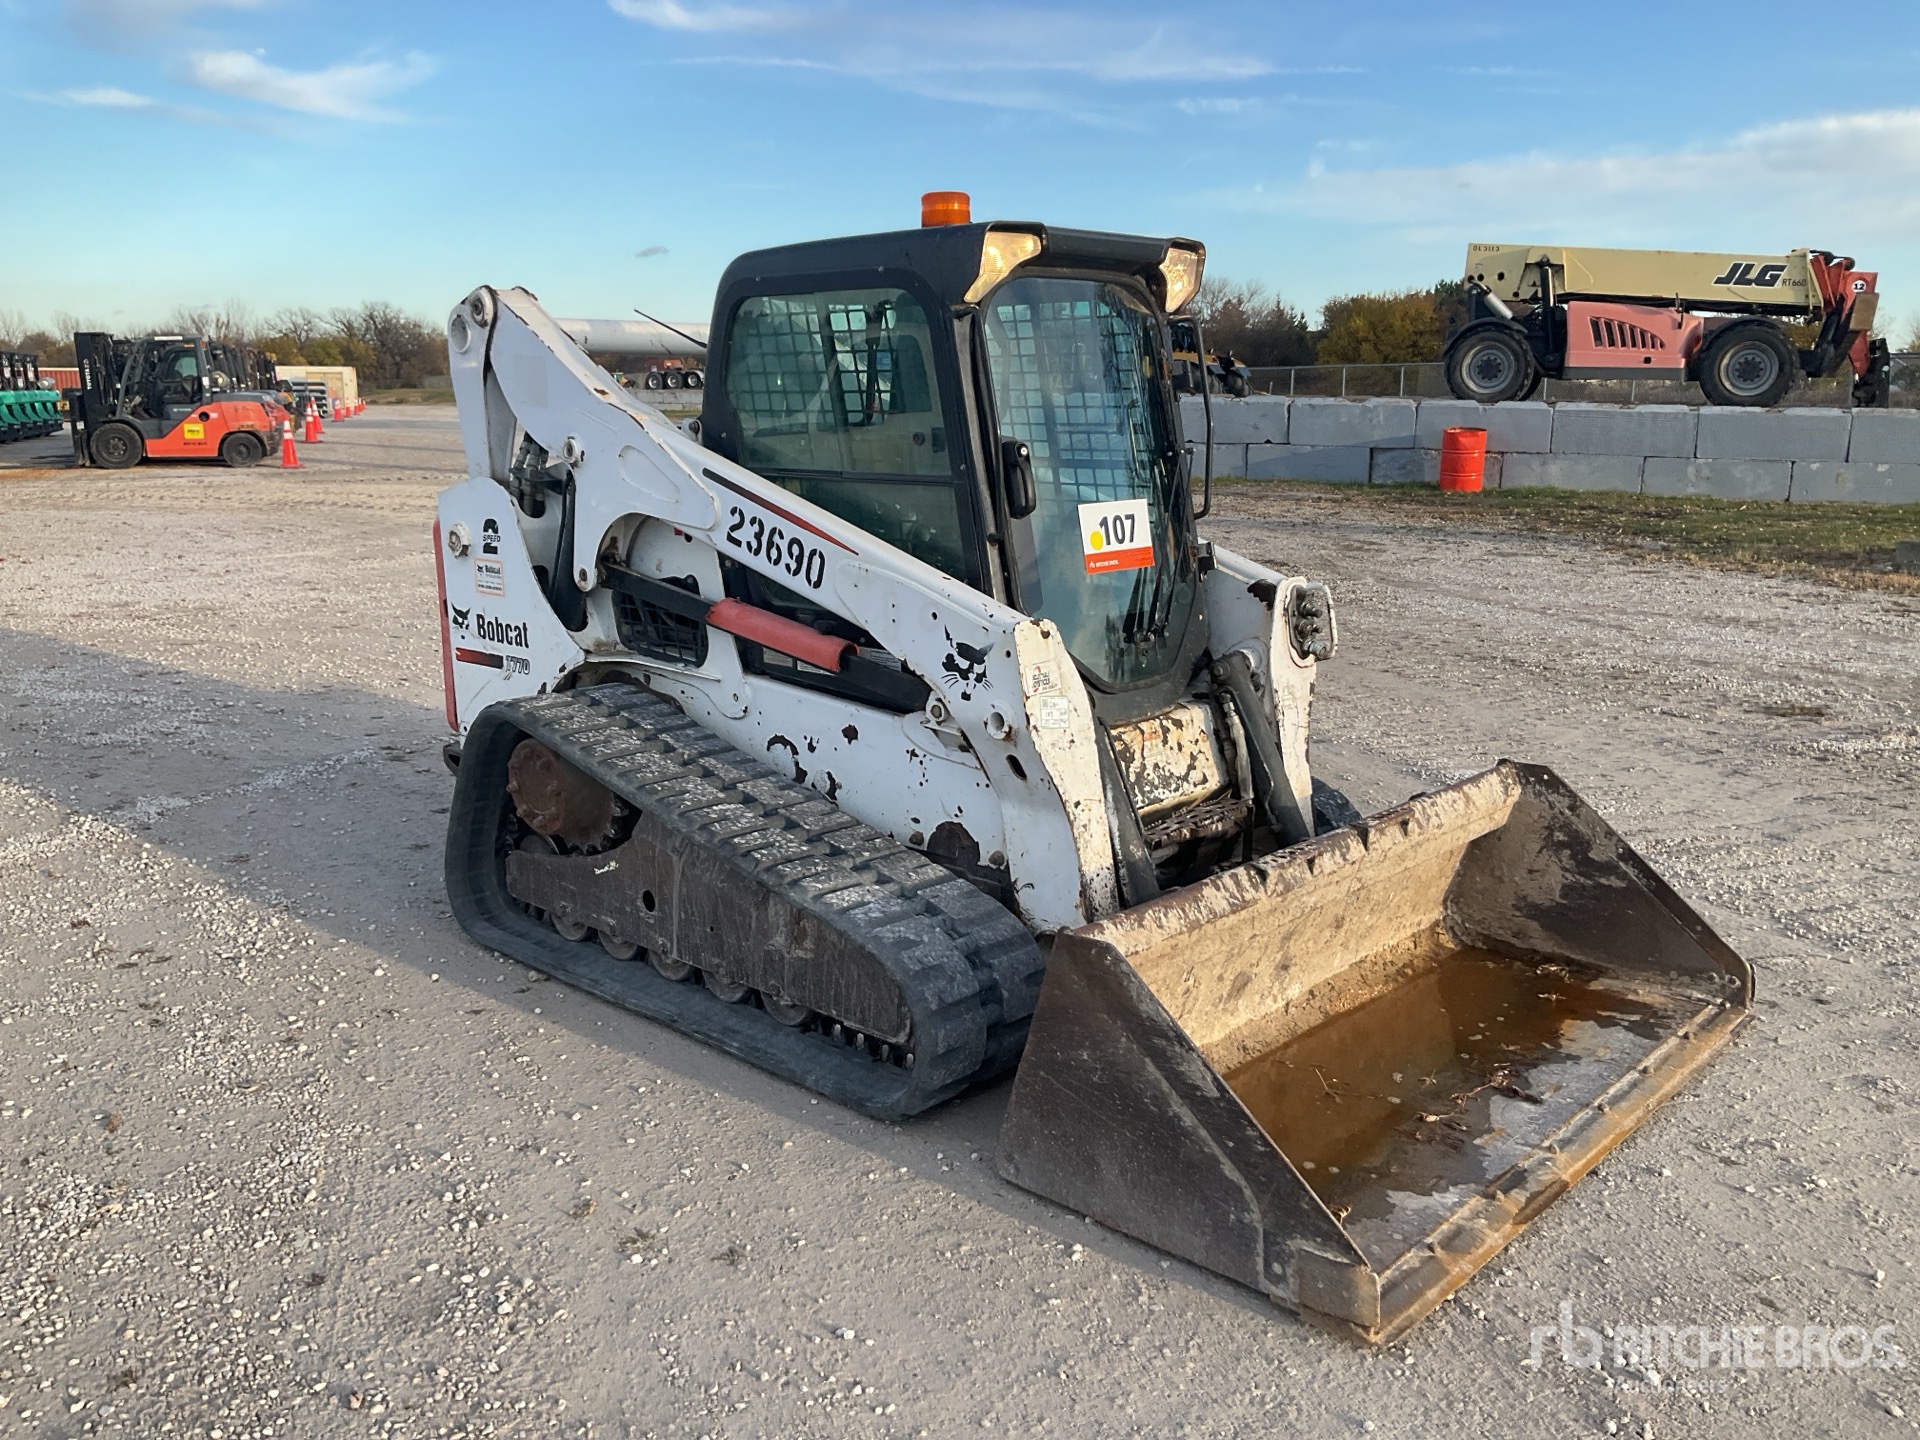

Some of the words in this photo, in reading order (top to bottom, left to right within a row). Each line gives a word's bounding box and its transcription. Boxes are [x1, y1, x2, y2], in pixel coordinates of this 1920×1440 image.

[1712, 261, 1788, 288] JLG
[482, 534, 501, 543] SPEED
[1098, 513, 1136, 546] 107
[726, 506, 826, 590] 23690
[476, 613, 530, 649] Bobcat
[505, 655, 531, 675] T770
